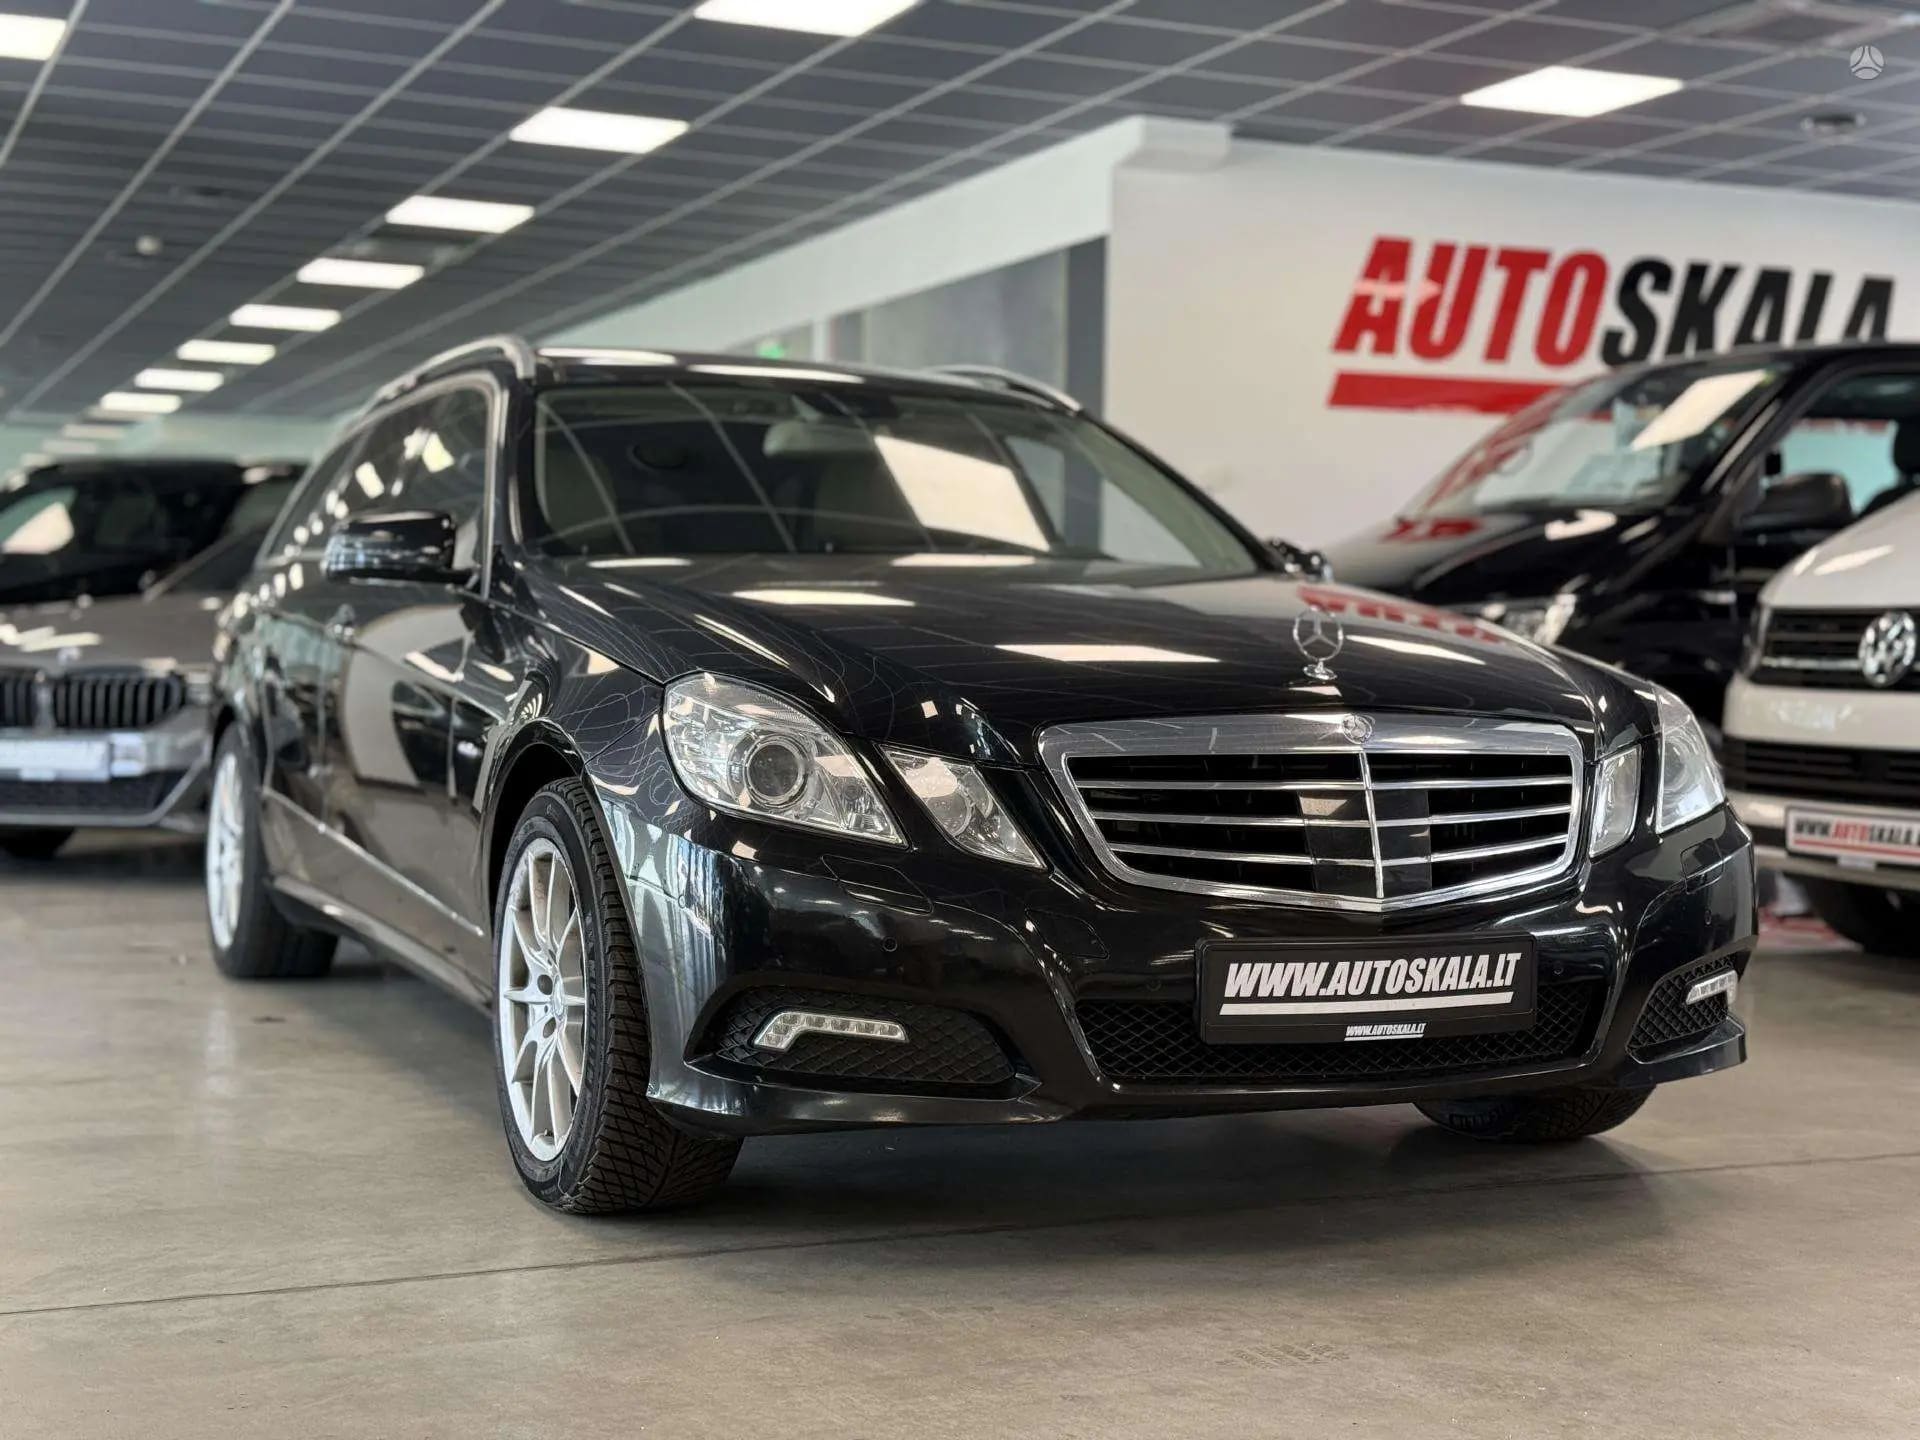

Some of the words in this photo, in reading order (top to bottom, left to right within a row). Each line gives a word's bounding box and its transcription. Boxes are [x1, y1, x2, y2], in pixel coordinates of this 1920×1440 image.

[1331, 235, 1896, 368] AUTOSKALA
[1223, 952, 1522, 998] WWW.AUTOSKALA.LT
[1345, 1022, 1427, 1038] WWW.AUTOSKALA.LT
